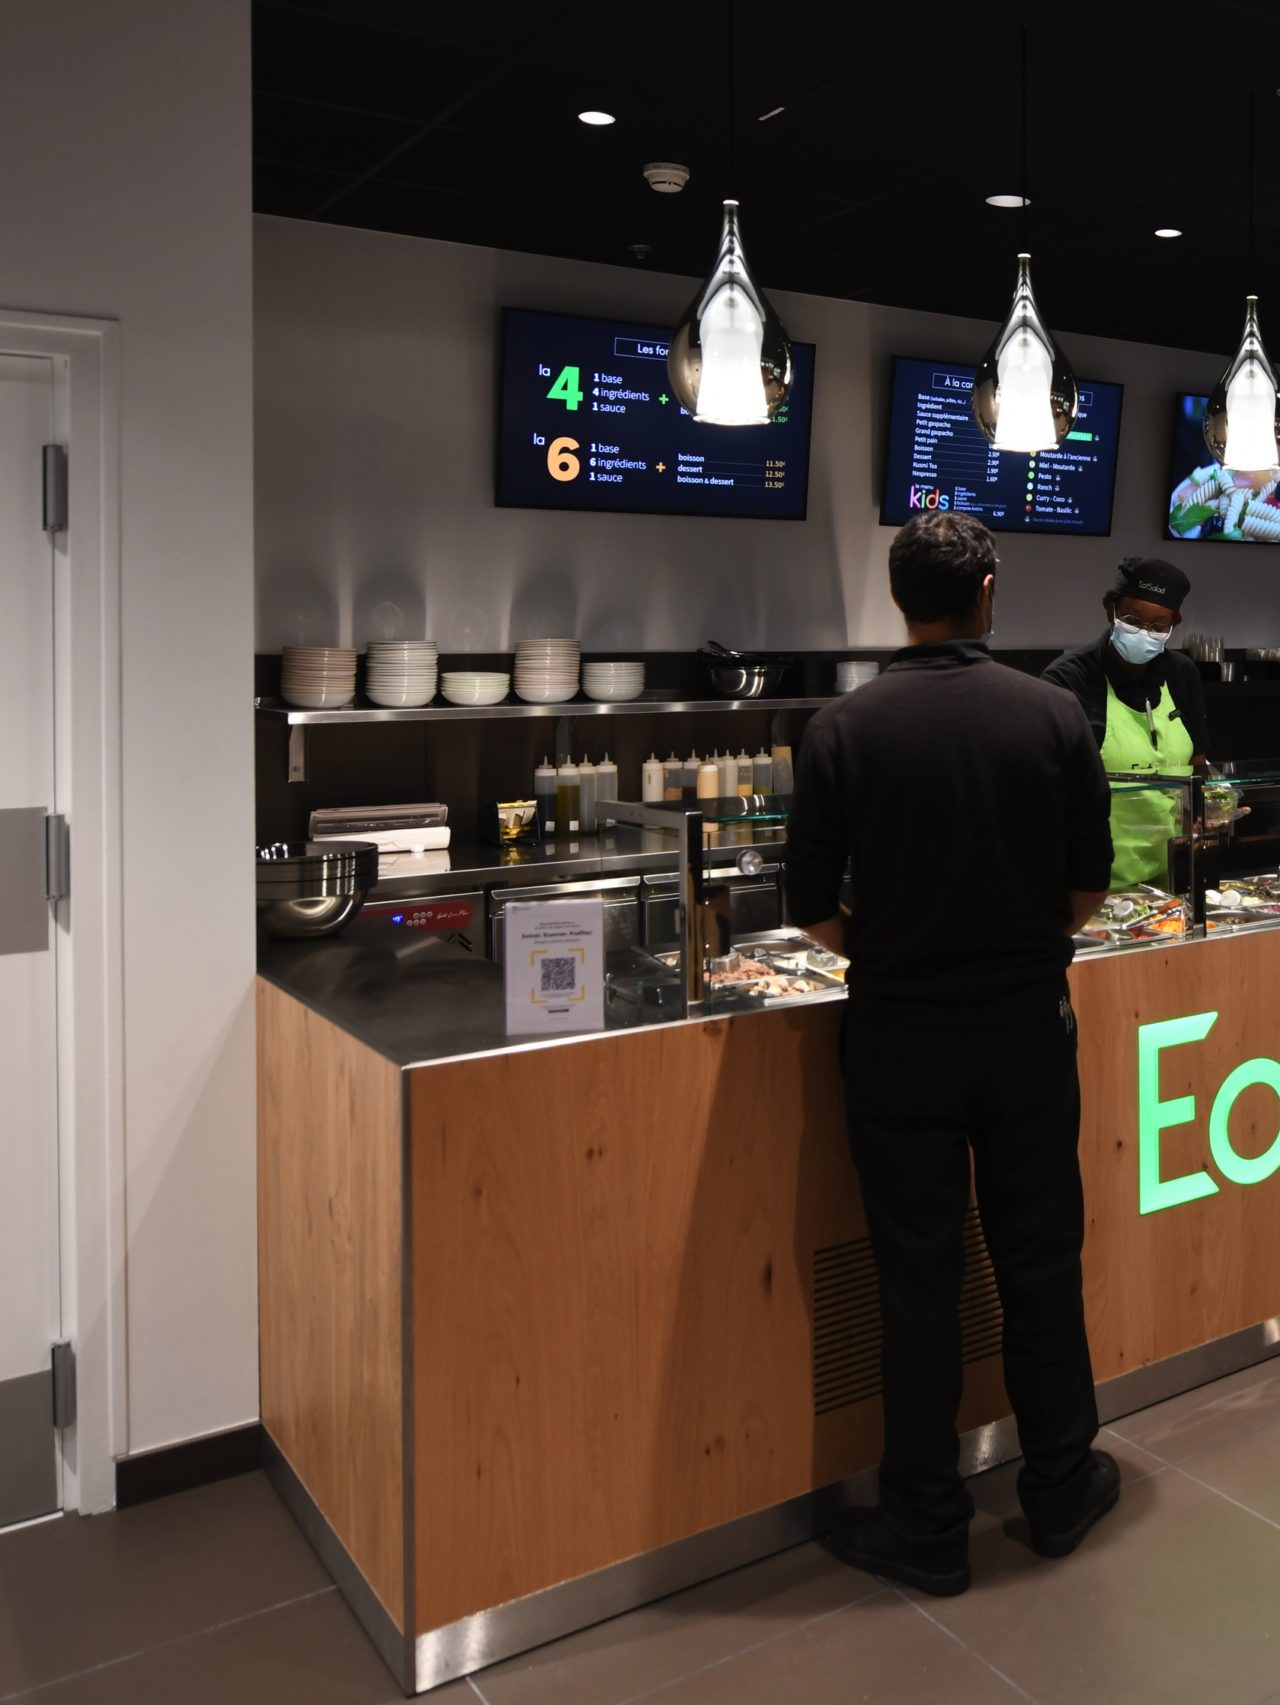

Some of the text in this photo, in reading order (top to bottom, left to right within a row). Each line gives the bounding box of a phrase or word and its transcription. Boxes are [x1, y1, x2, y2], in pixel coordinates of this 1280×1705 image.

[638, 344, 653, 354] Les
[594, 374, 623, 384] 1 base
[945, 375, 974, 389] À la car
[539, 364, 583, 411] la 4
[593, 388, 599, 396] 4
[601, 388, 650, 401] ingrédients
[592, 402, 626, 413] 1 sauce
[931, 429, 954, 437] gaspacho
[591, 444, 619, 453] 1 base
[533, 433, 580, 482] la 6
[679, 453, 705, 463] boisson
[1040, 451, 1063, 459] Moutarde
[590, 458, 596, 467] 6
[598, 458, 646, 470] ingrédients
[678, 465, 703, 473] dessert
[589, 472, 623, 482] 1 sauce
[912, 470, 938, 478] Nespresso
[677, 475, 704, 484] boisson
[710, 477, 734, 486] dessert
[910, 486, 950, 510] kids
[1139, 581, 1166, 594] EatSalad
